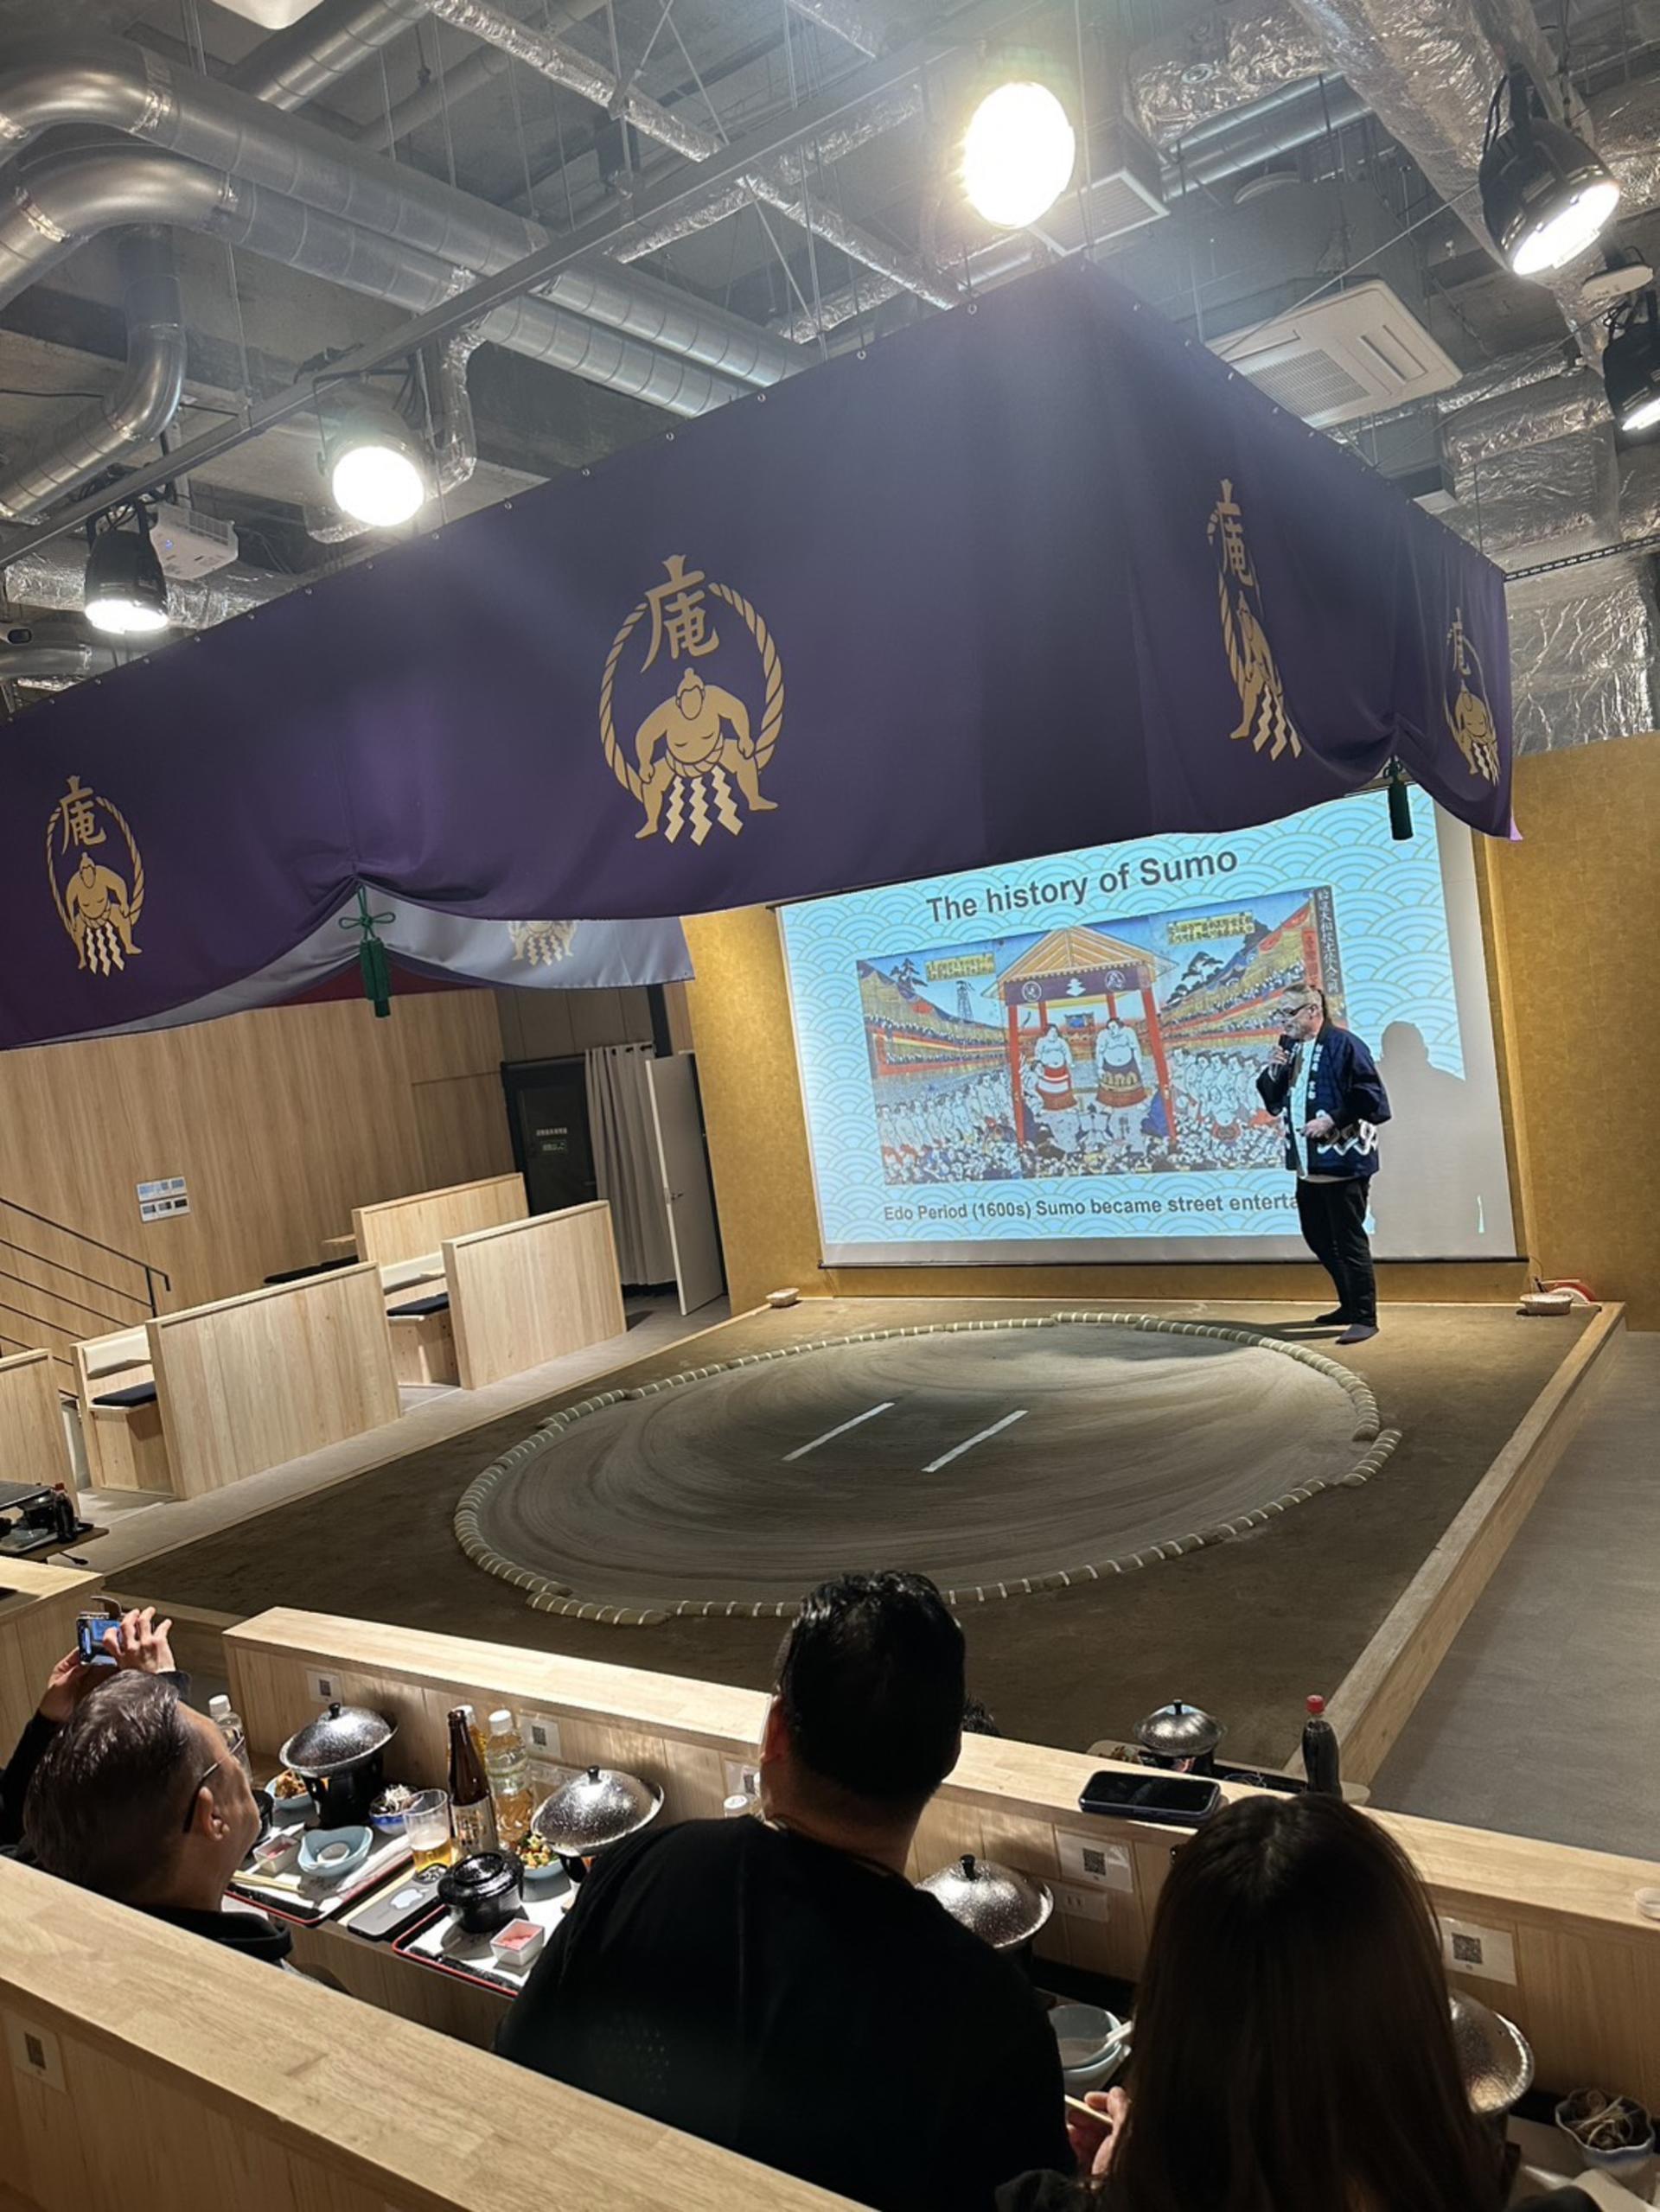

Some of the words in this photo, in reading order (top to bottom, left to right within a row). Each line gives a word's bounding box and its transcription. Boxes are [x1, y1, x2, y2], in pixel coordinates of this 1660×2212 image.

[640, 554, 720, 674] 庵
[59, 775, 107, 856] 庵
[926, 896, 978, 923] The
[986, 877, 1089, 914] history
[1099, 862, 1131, 892] of
[1140, 851, 1238, 887] Sumo
[884, 1205, 914, 1221] Edo
[918, 1202, 968, 1221] Period
[973, 1201, 1031, 1221] (1600s)
[1036, 1199, 1086, 1216] Sumo
[1089, 1197, 1163, 1214] became
[1167, 1194, 1223, 1212] street
